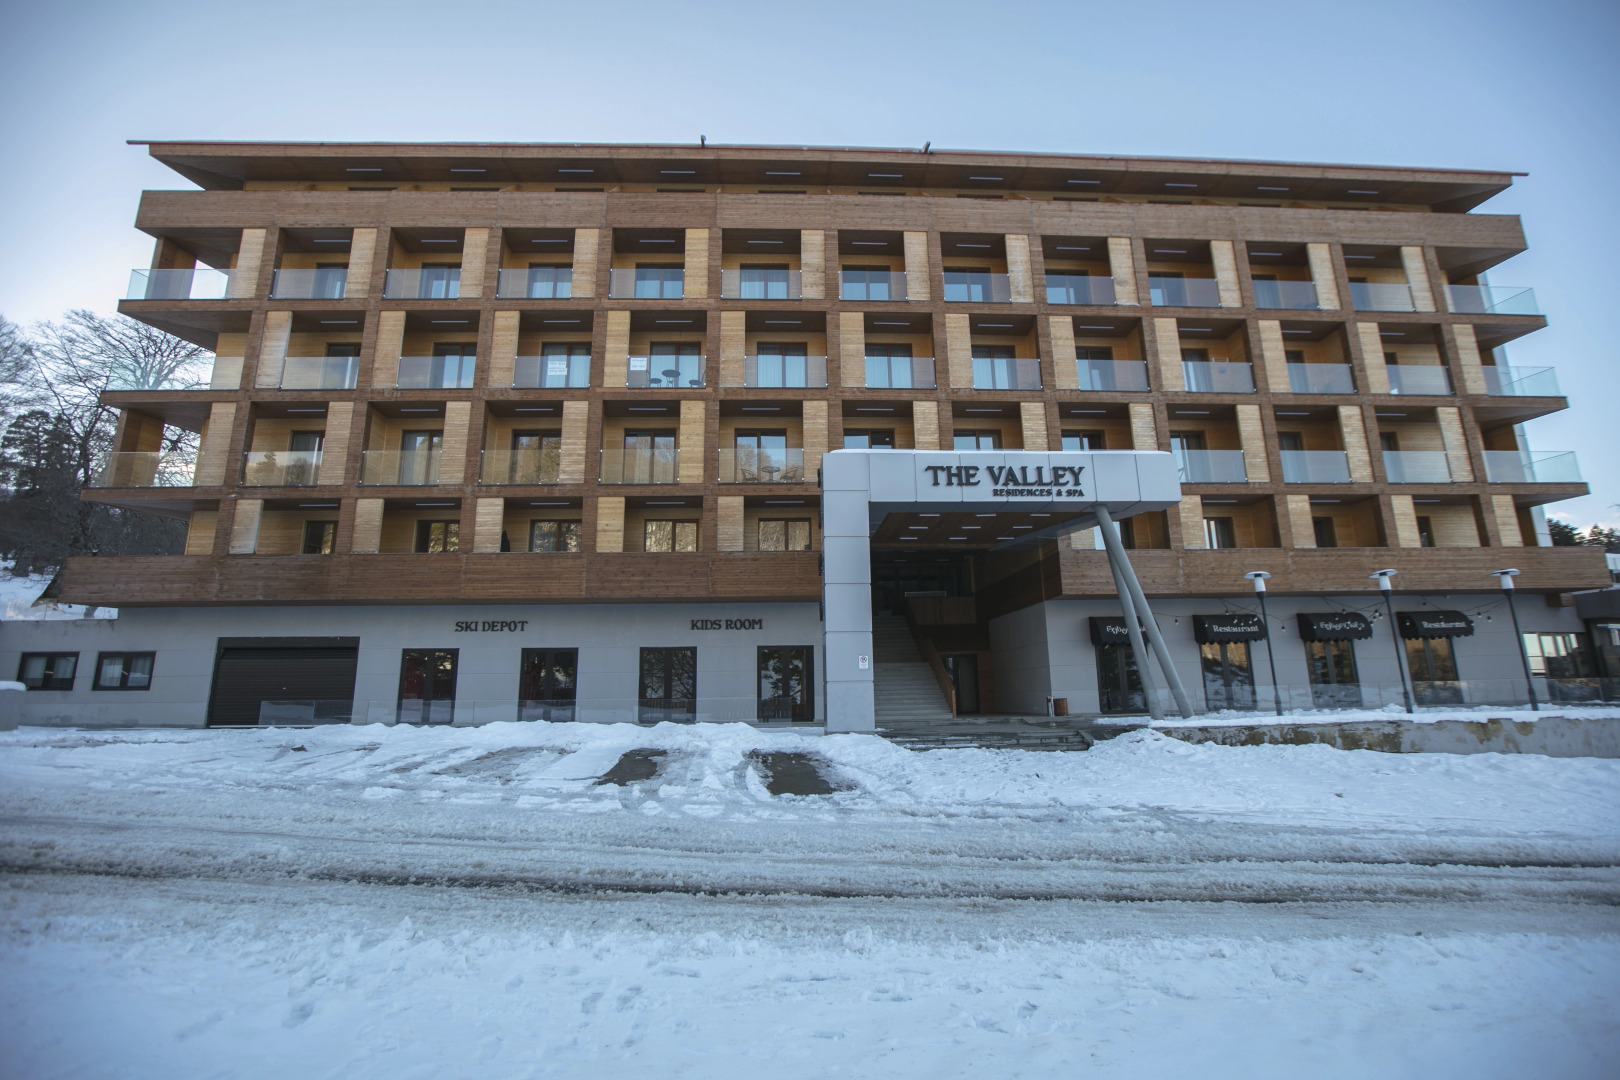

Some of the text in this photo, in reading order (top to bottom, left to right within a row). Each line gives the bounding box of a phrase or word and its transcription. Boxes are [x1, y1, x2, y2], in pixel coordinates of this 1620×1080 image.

[925, 465, 1085, 486] THE VALLEY
[992, 488, 1085, 497] RESIDENCES & SPA
[454, 620, 529, 632] SKI DEPOT
[690, 618, 763, 631] KIDS ROOM
[1212, 624, 1259, 633] Restaurant
